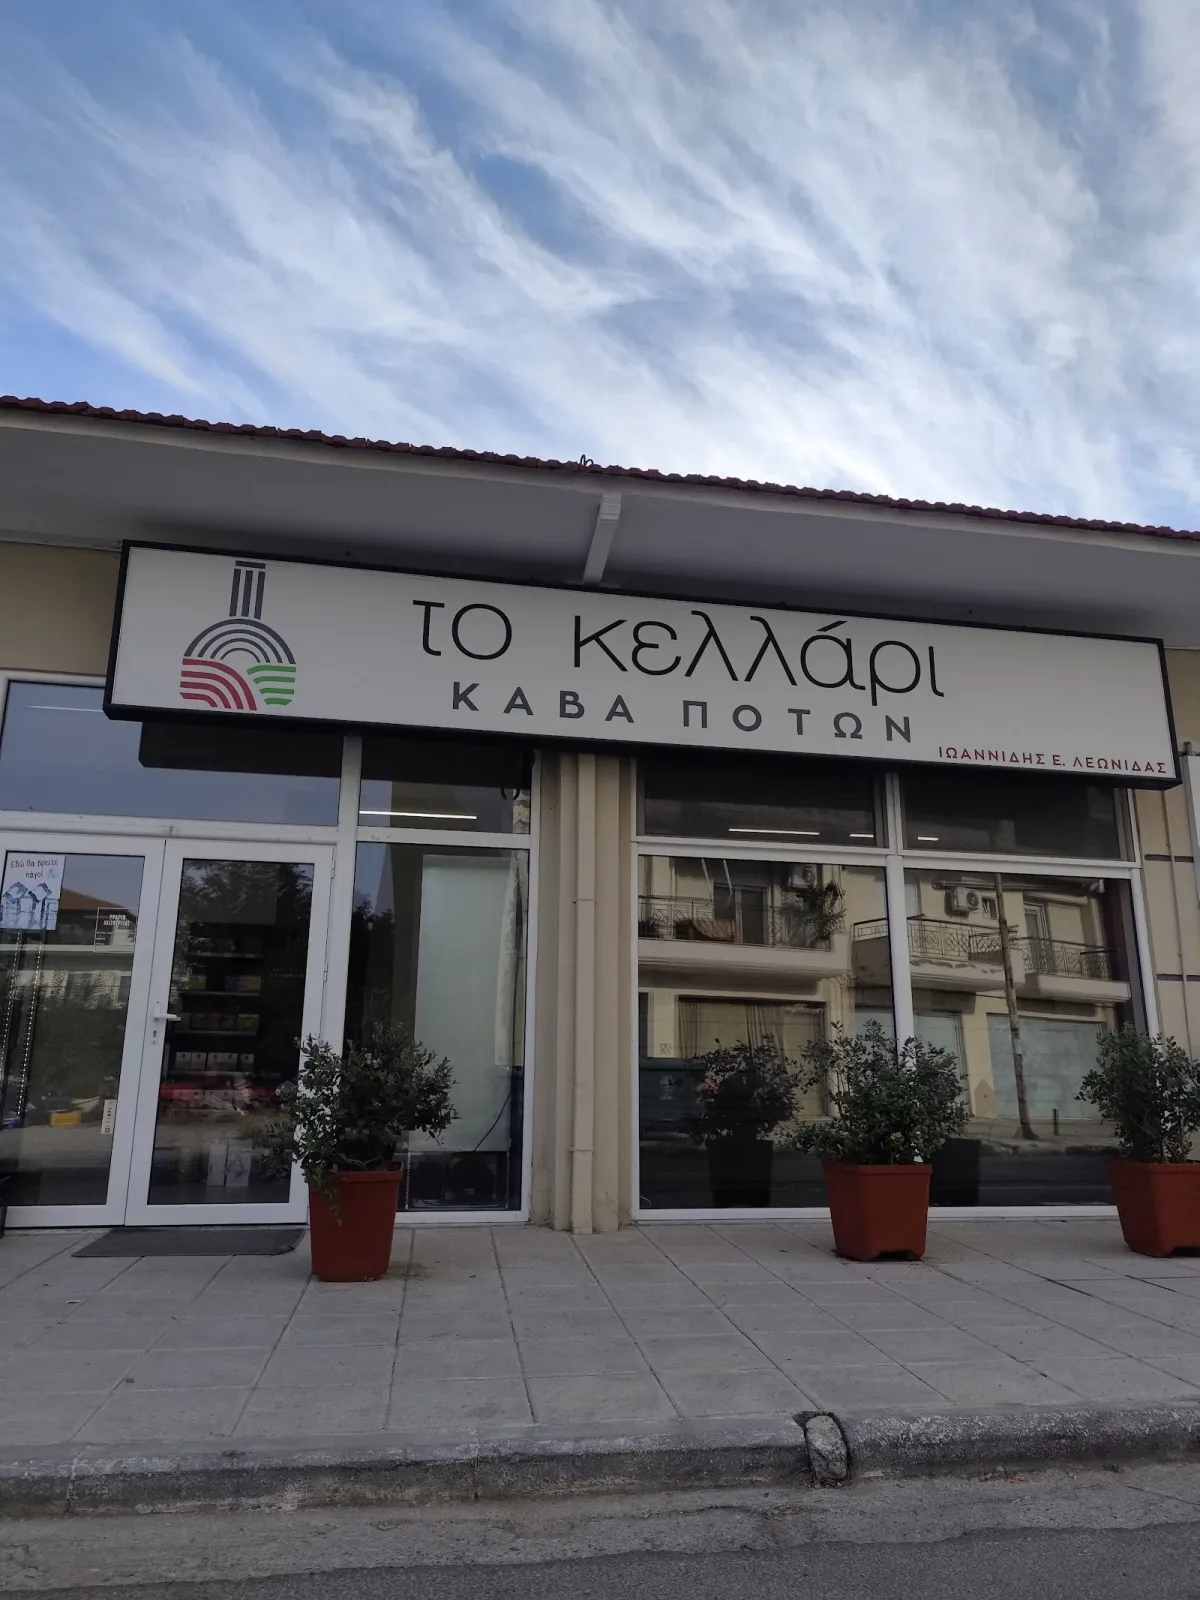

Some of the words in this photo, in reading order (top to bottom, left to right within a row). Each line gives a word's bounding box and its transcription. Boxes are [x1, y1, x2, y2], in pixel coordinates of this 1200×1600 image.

[412, 599, 513, 661] το
[452, 681, 635, 724] ΚΑΒΑ
[682, 699, 912, 743] ΠΟΤΩΝ
[938, 746, 1046, 765] ΙΩΑΝΝΙΔΗΣ
[1072, 756, 1167, 774] ΛΕΩΝΙΔΑΣ
